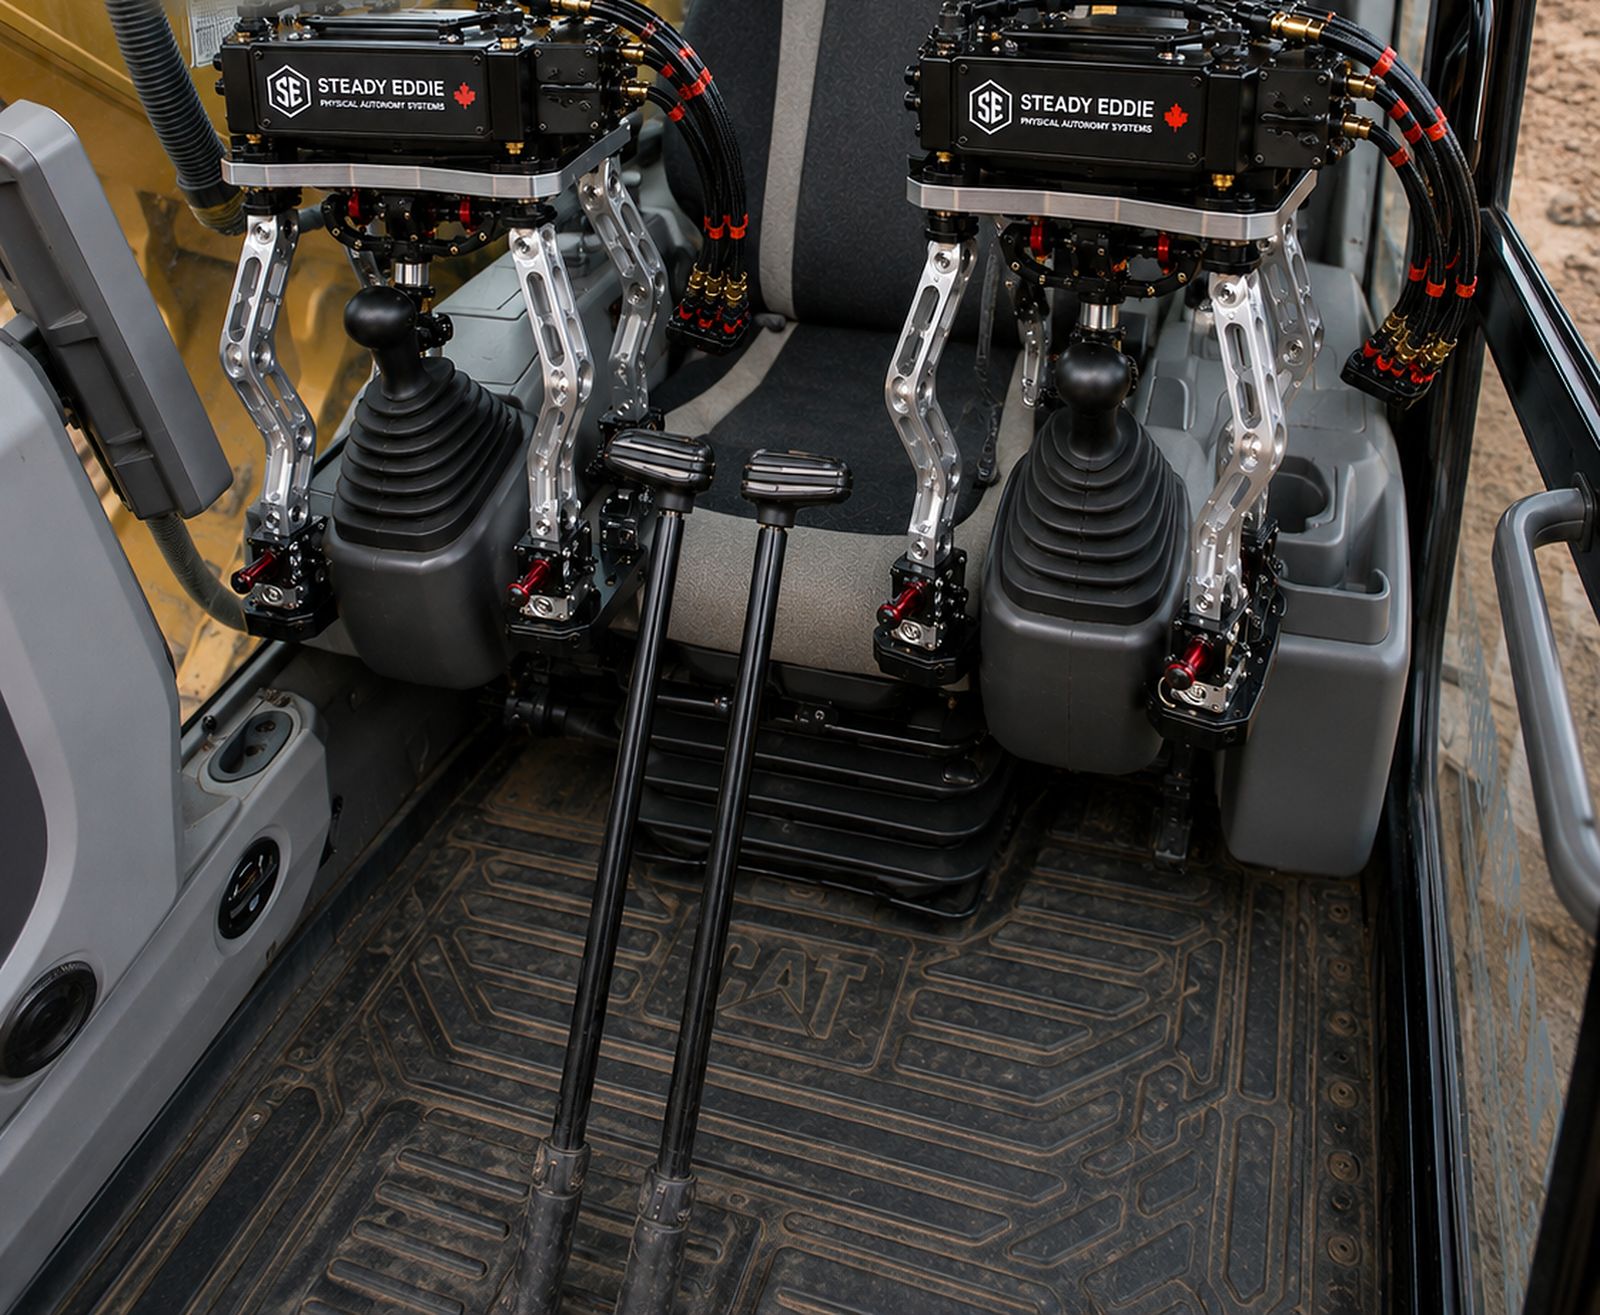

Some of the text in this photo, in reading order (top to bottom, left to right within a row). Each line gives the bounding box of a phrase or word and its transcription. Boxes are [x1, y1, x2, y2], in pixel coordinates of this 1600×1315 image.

[275, 76, 303, 108] SE
[317, 77, 445, 97] STEADY EDDIE
[320, 99, 358, 108] PHYSICAL
[977, 91, 1003, 124] SE
[1020, 93, 1155, 118] STEADY EDDIE
[1020, 117, 1060, 127] PHYSICAL
[1111, 123, 1153, 134] SYSTEMS
